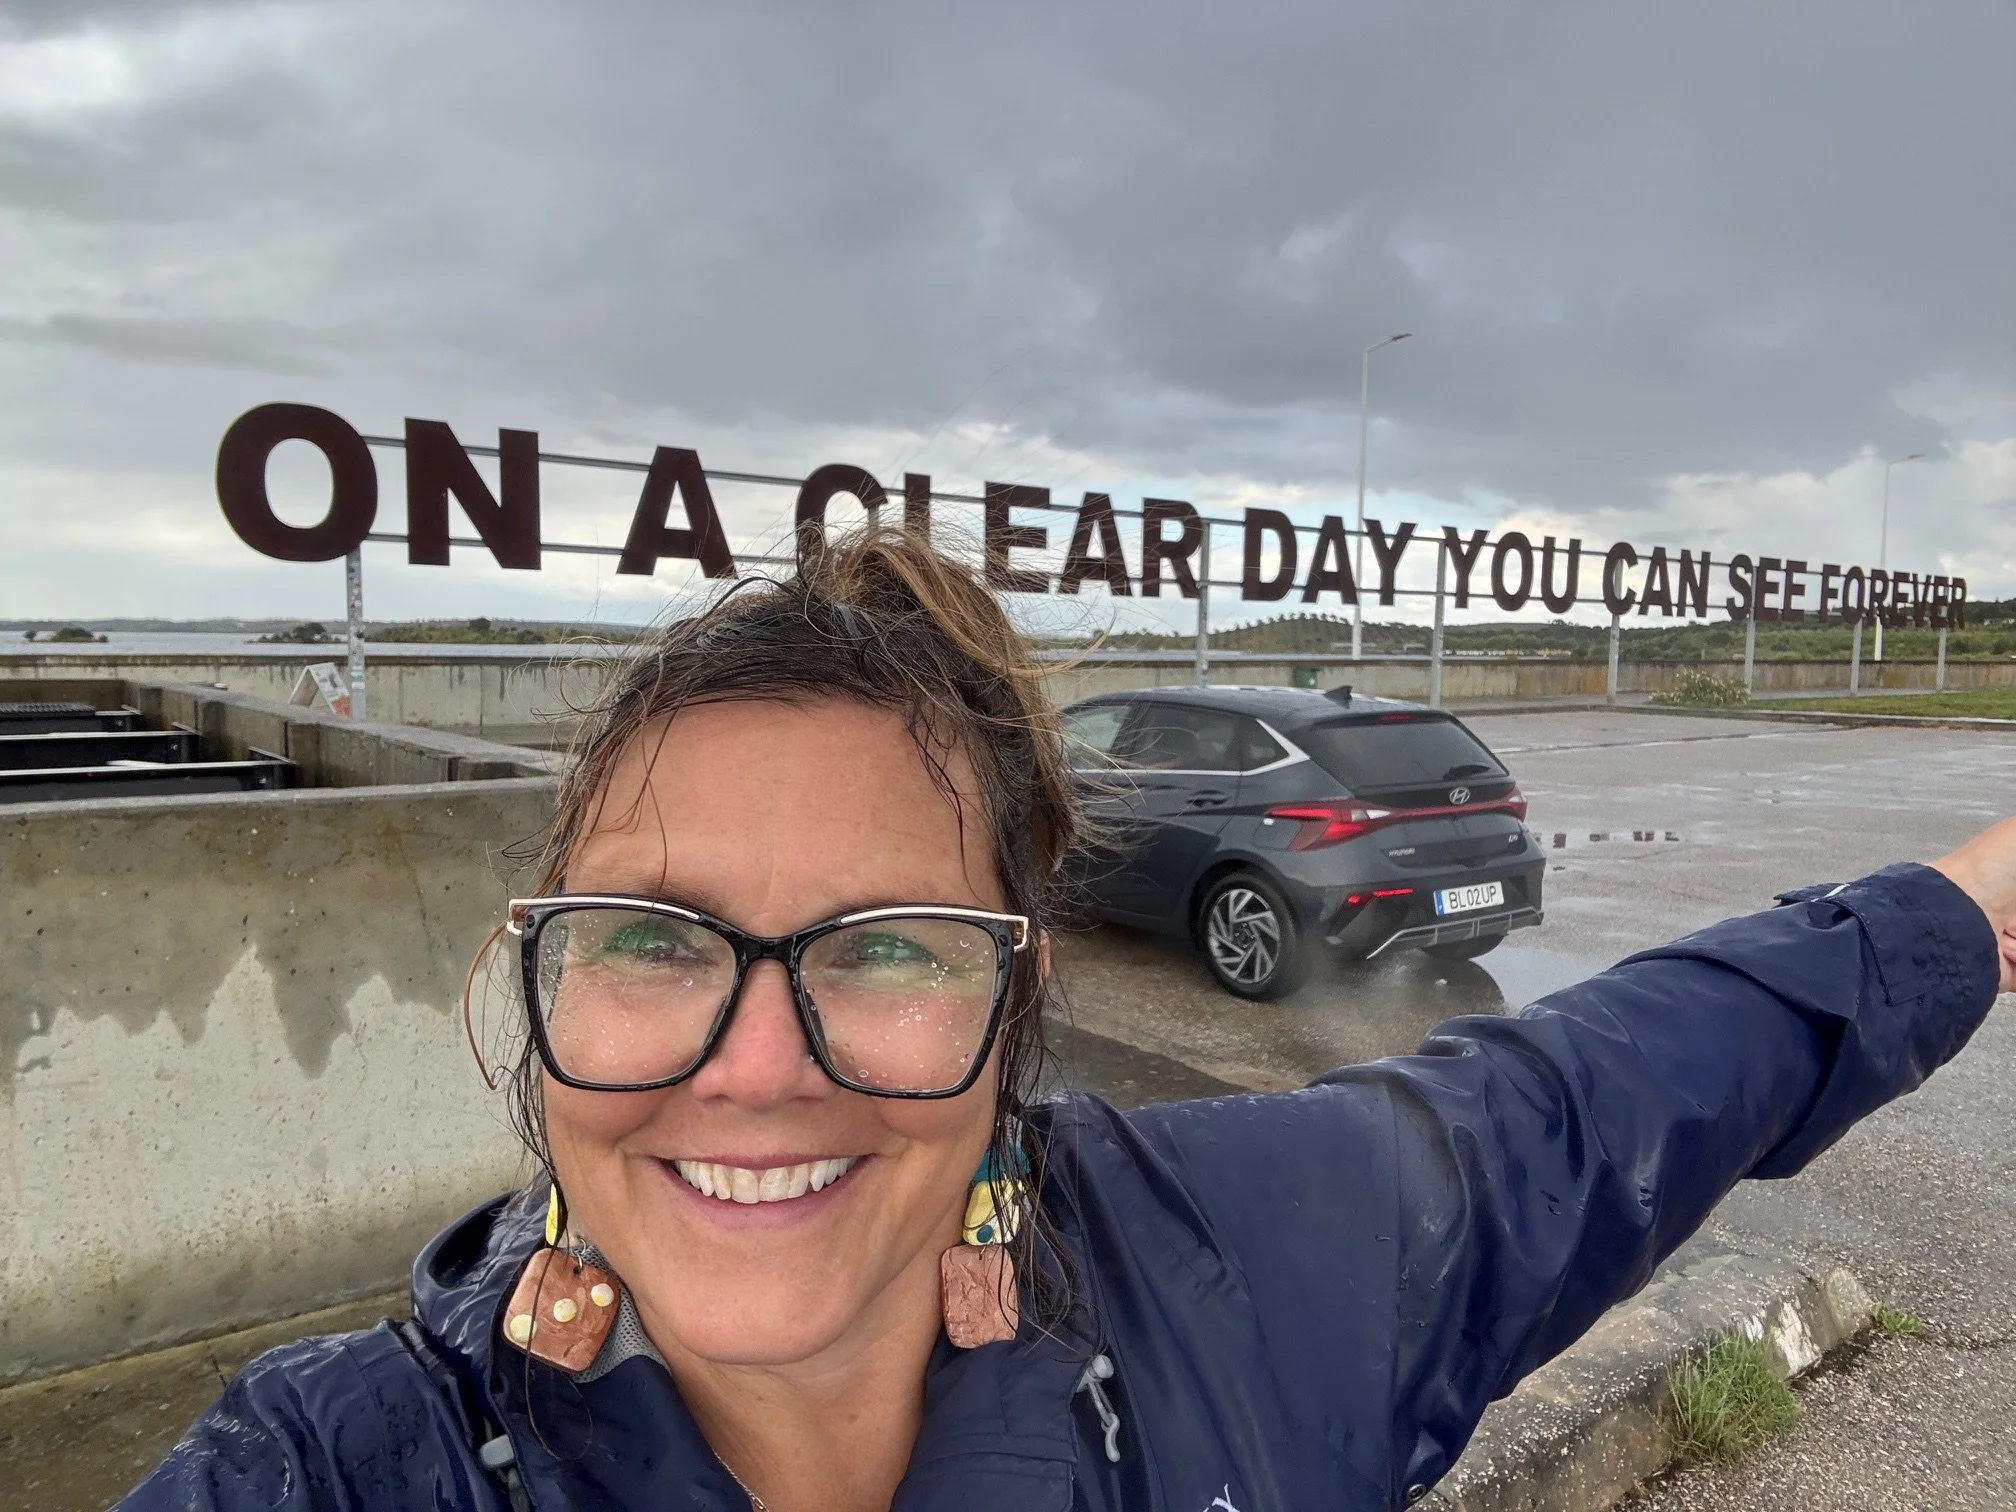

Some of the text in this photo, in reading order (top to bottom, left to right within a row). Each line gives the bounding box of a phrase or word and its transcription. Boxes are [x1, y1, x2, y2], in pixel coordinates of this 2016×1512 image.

[216, 401, 541, 571] ON
[615, 445, 738, 579] A
[1242, 507, 1418, 606] DAY
[1441, 525, 1582, 614] YOU
[1602, 541, 1711, 617] CAN
[1726, 553, 1808, 622] SEE
[1819, 562, 1967, 630] FOREVER
